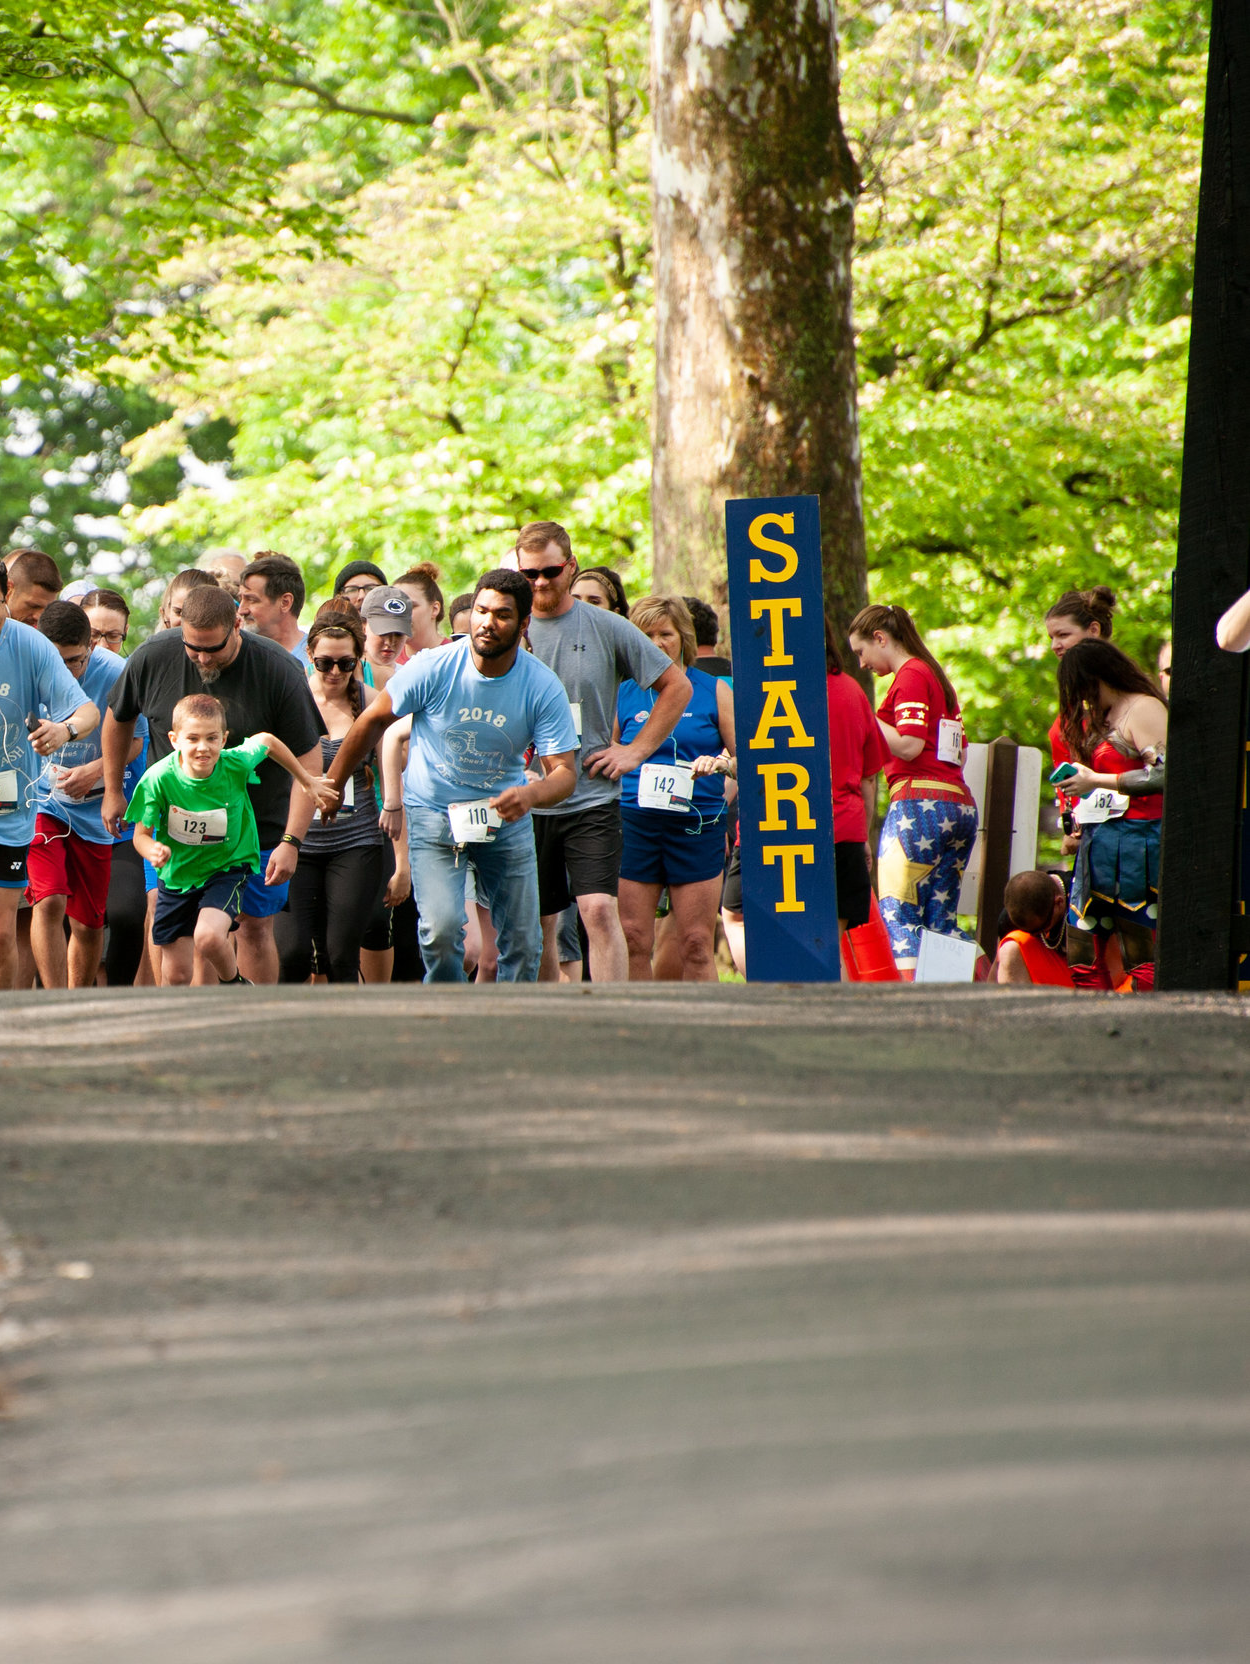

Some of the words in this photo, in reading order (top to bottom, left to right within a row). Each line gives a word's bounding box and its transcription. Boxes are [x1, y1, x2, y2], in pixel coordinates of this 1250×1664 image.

[458, 707, 507, 728] 2018
[749, 511, 817, 913] START
[654, 776, 675, 794] 142
[1094, 793, 1114, 809] 152
[468, 807, 488, 825] 110
[184, 820, 207, 835] 123
